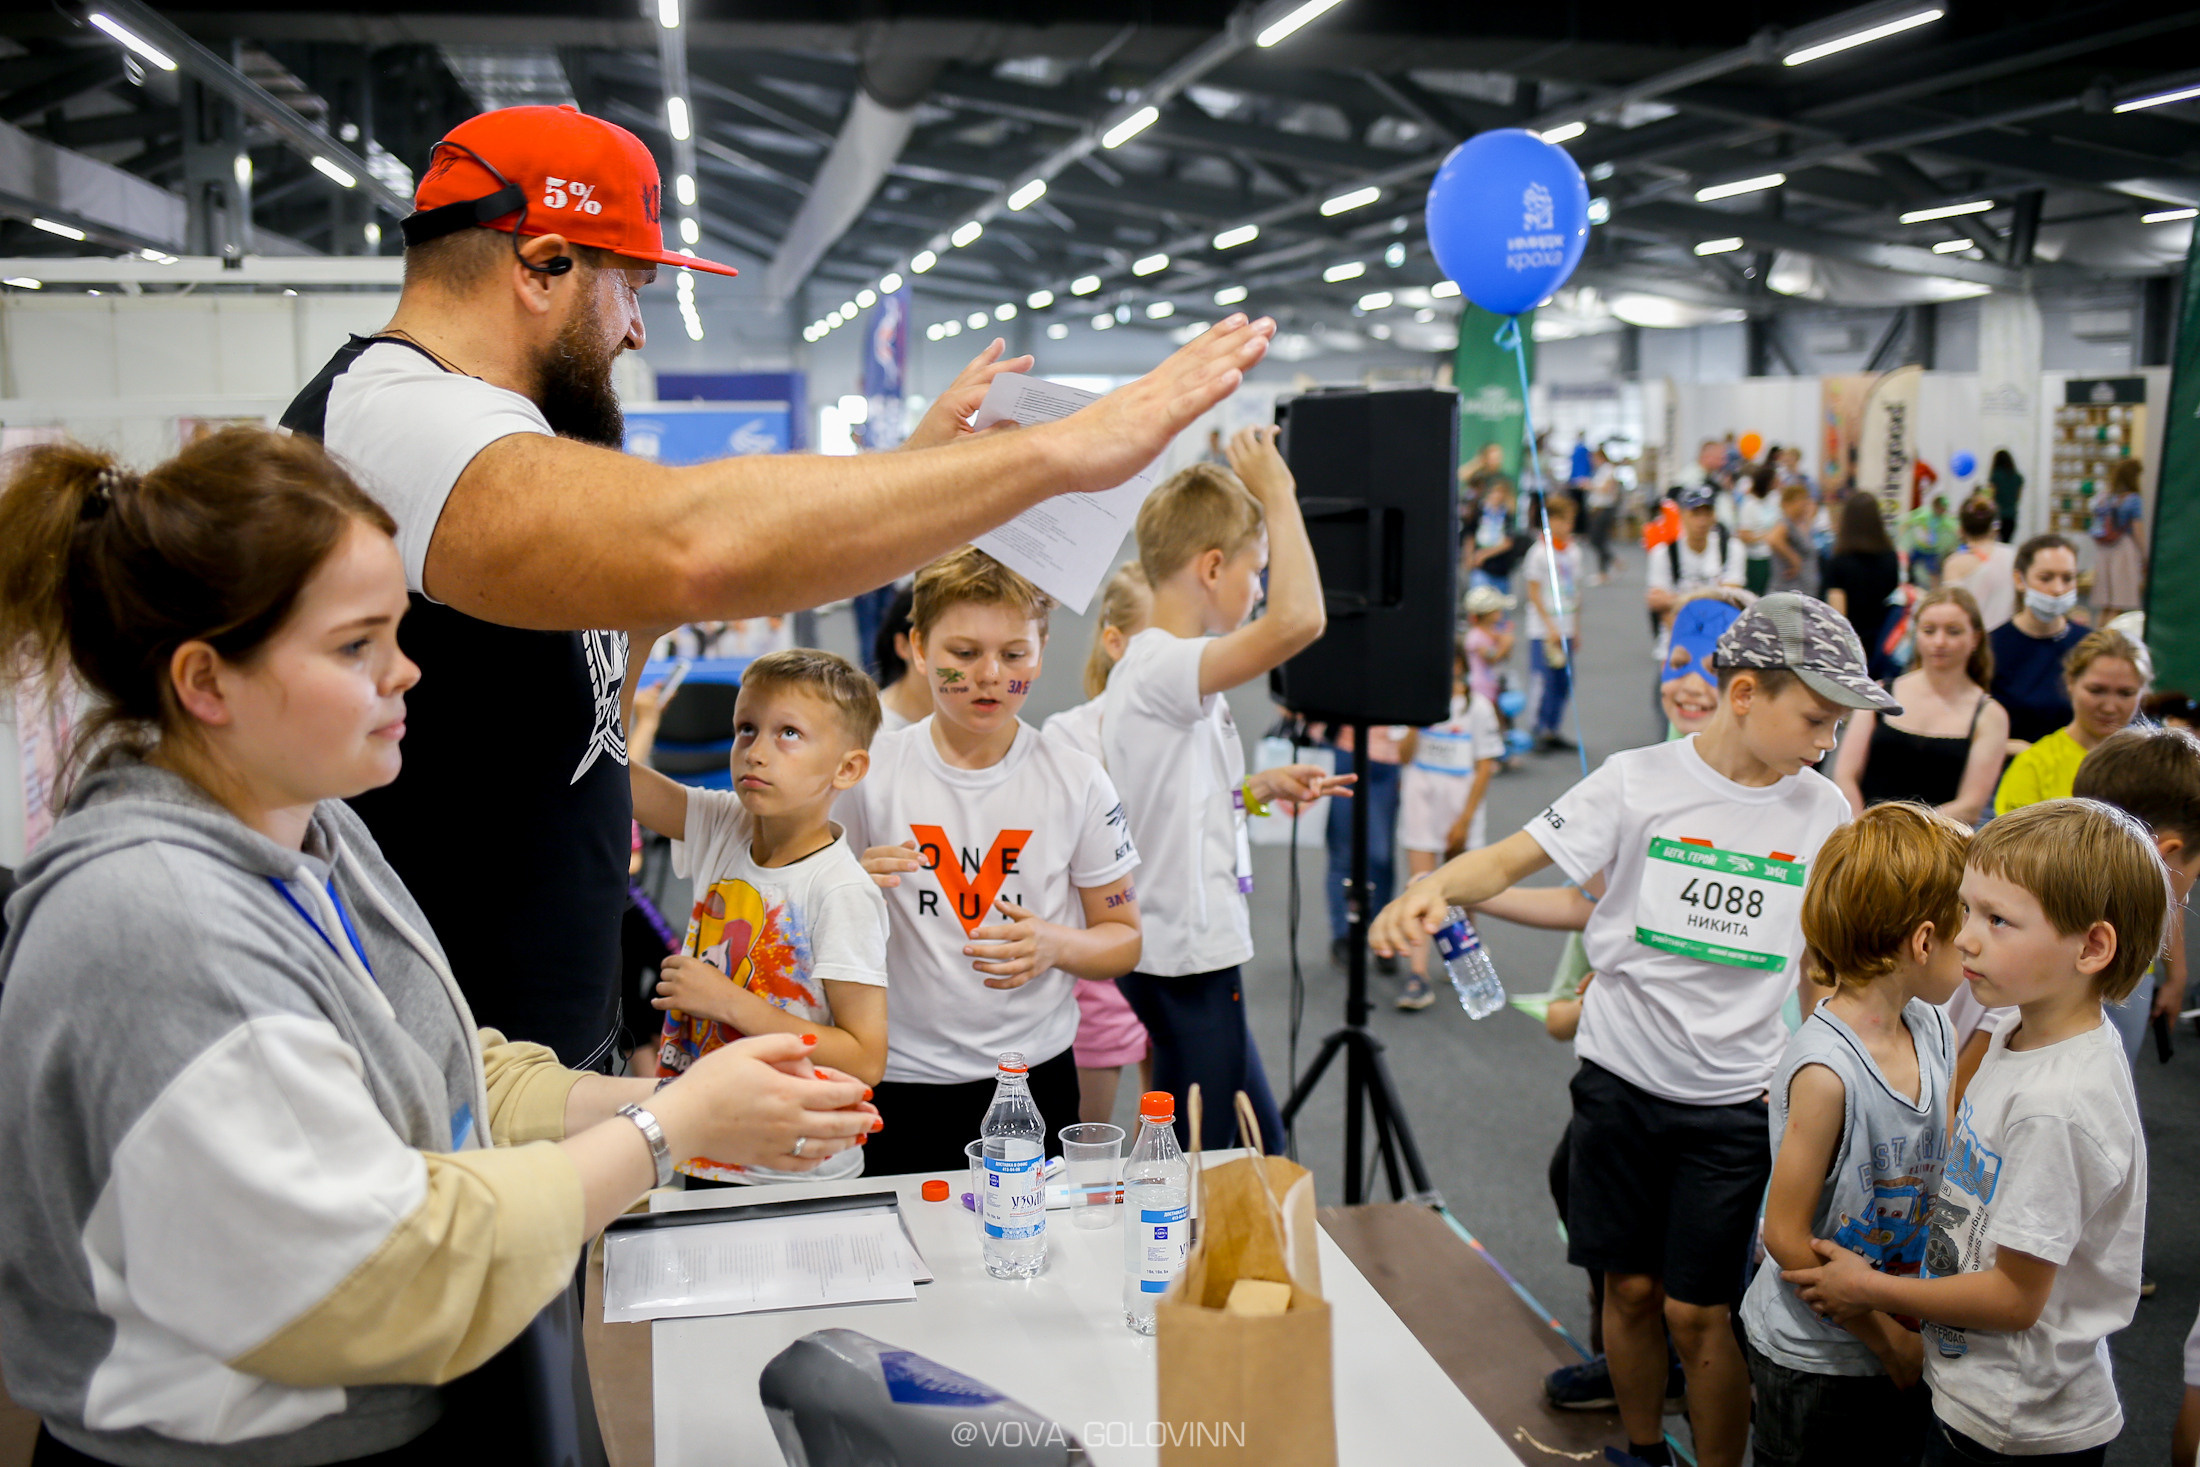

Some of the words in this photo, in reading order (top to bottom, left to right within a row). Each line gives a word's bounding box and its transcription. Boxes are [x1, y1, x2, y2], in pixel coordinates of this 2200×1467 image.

[543, 176, 603, 215] 5%
[1506, 251, 1563, 273] кроха
[918, 843, 1021, 875] ONE
[1663, 846, 1686, 861] БЕГИ,
[1688, 850, 1719, 866] ГЕРОЙ!
[1680, 878, 1764, 918] 4088
[1687, 914, 1749, 937] НИКИТА
